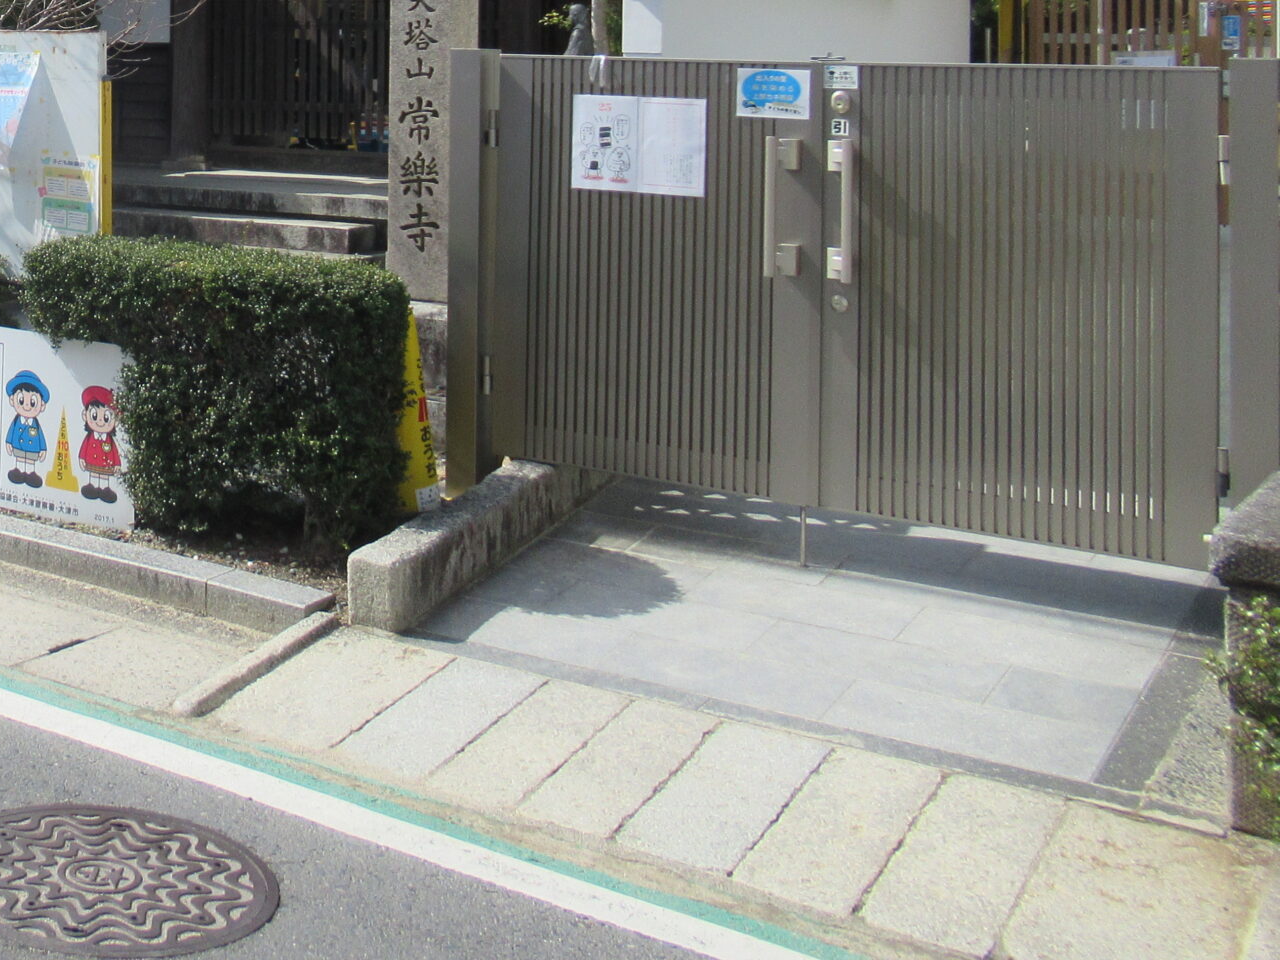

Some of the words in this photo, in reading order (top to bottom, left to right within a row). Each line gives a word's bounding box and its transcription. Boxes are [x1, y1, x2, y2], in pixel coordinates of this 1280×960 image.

[58, 440, 70, 451] 110
[420, 425, 437, 479] おうち
